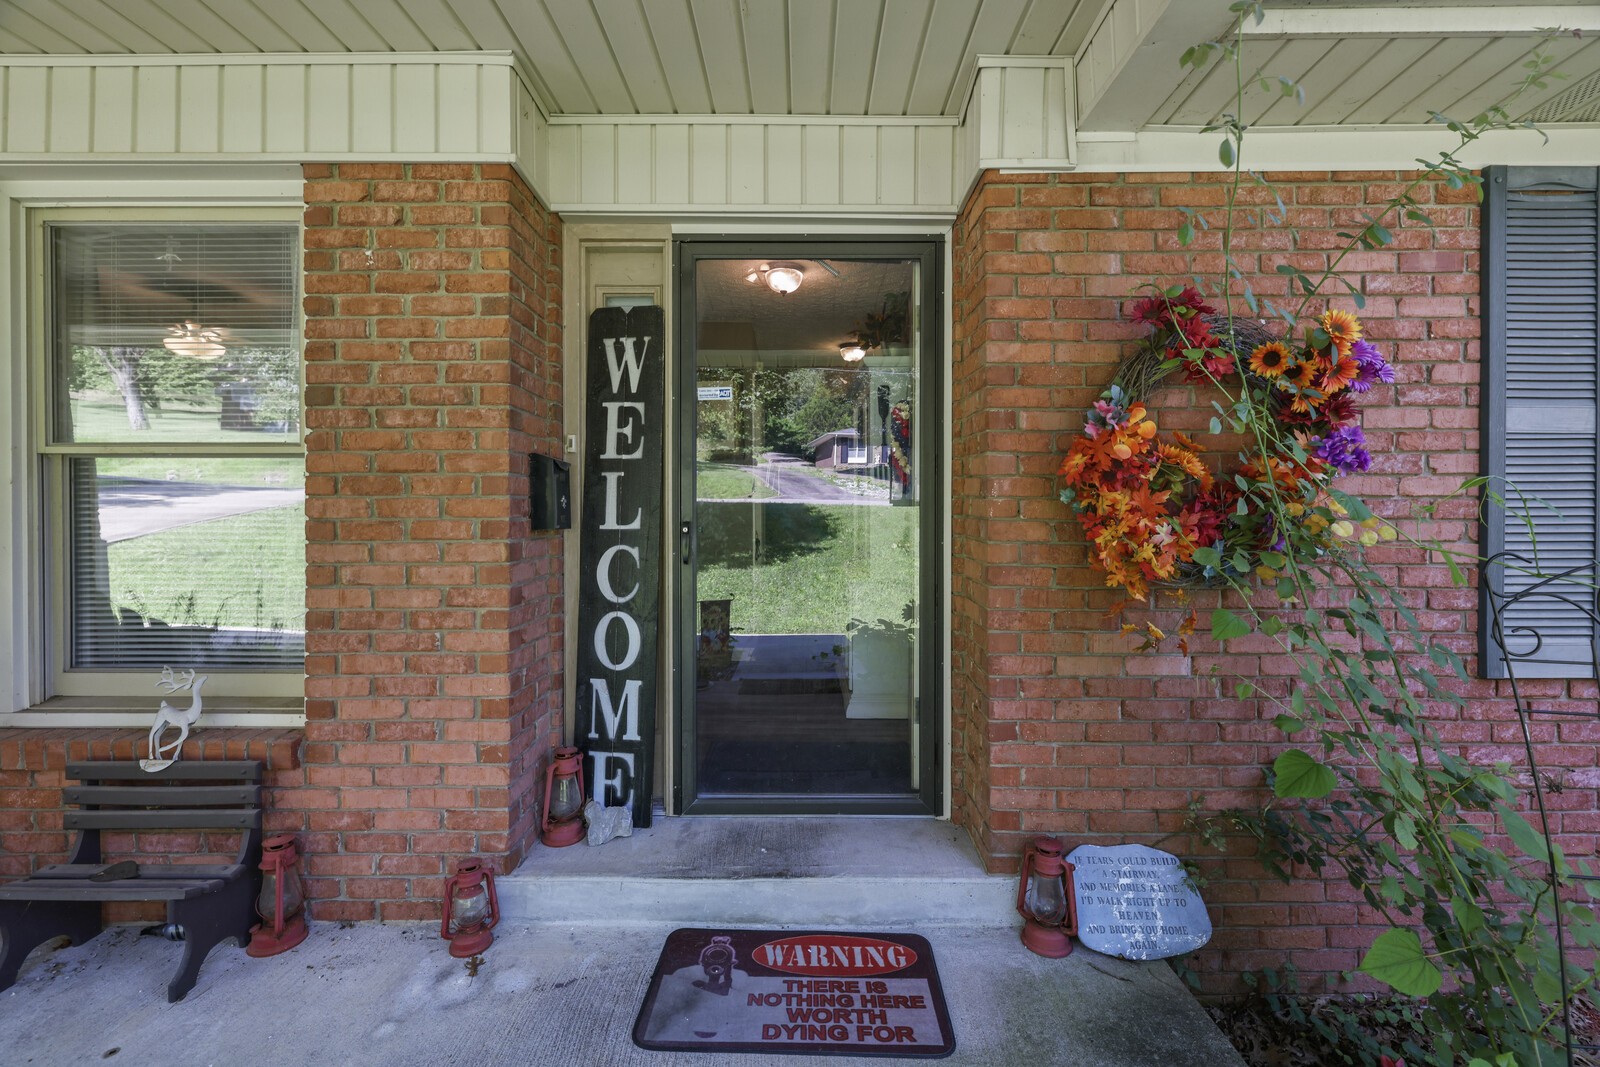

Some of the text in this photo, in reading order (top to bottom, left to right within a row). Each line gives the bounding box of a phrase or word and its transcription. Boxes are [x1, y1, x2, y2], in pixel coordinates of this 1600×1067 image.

[719, 389, 730, 398] ADT
[587, 336, 651, 811] WELCOME
[1074, 856, 1177, 866] IF TEARS COULD BUILD
[1102, 869, 1108, 879] A
[1080, 882, 1096, 892] AND
[1099, 883, 1147, 893] MEMORIES
[1150, 884, 1156, 893] A
[1080, 896, 1187, 908] I'D WALK RIGHT UP TO
[1118, 911, 1158, 921] HEAVEN
[1088, 925, 1189, 936] AND BRING YOU HOME
[764, 944, 907, 968] WARNING
[783, 980, 888, 994] THERE IS
[747, 993, 927, 1009] NOTHING HERE
[786, 1008, 888, 1024] WORTH
[762, 1024, 917, 1043] DYING FOR
